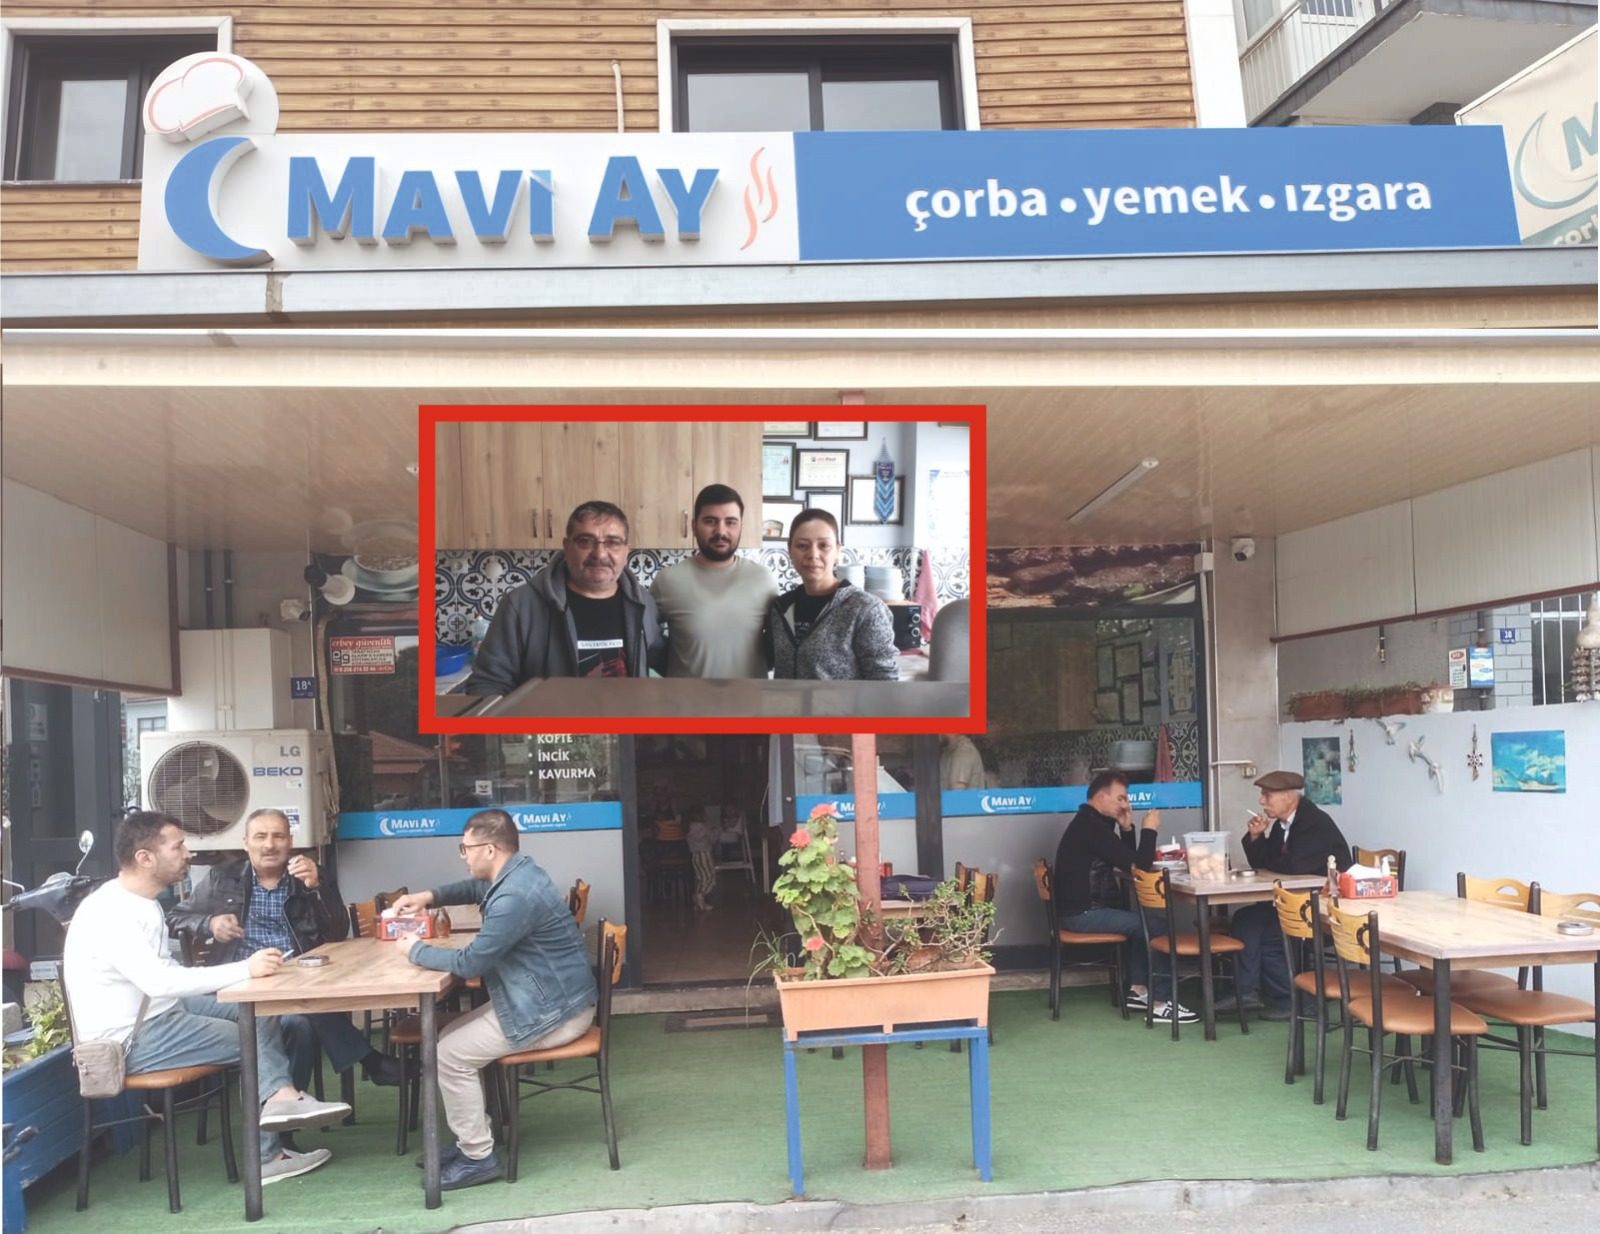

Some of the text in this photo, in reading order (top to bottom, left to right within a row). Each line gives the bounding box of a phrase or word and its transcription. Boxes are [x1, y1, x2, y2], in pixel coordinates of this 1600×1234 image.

[589, 156, 719, 240] AY
[906, 175, 1432, 231] çorba yemek ızgara
[280, 745, 301, 757] LG
[538, 748, 570, 762] İNCİK
[253, 766, 304, 777] BEKO
[538, 767, 596, 779] KAVURMA
